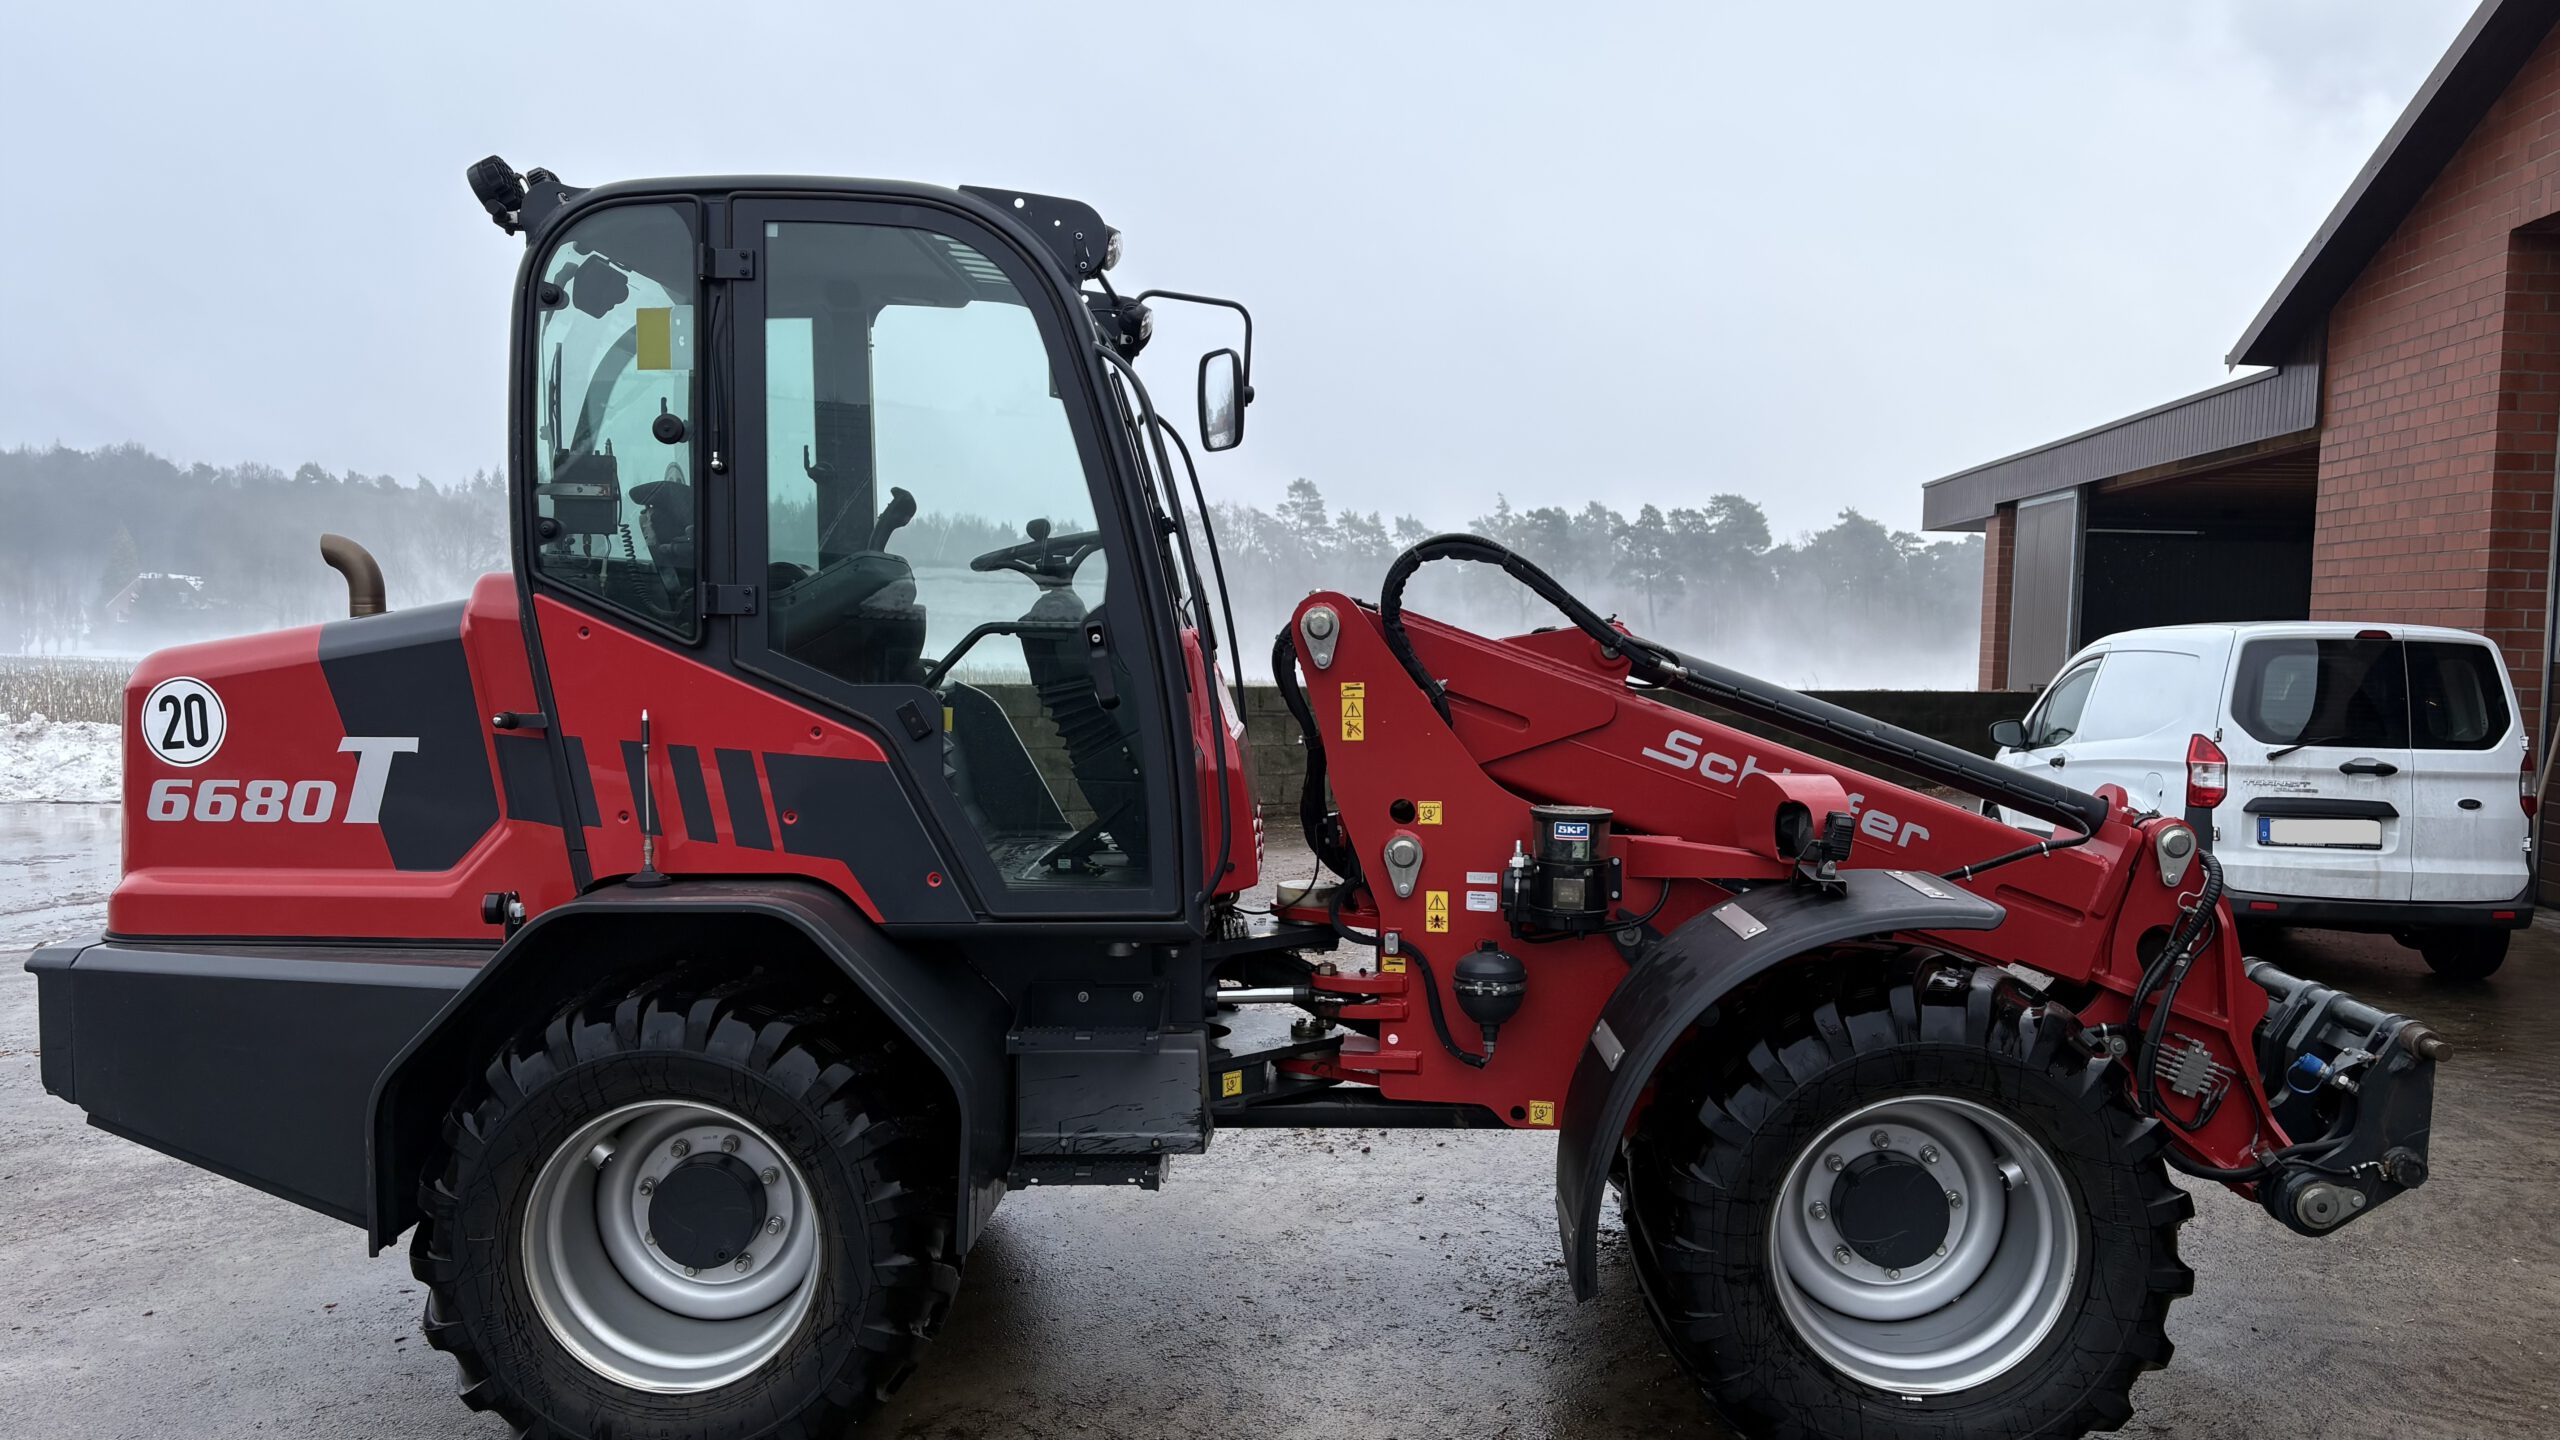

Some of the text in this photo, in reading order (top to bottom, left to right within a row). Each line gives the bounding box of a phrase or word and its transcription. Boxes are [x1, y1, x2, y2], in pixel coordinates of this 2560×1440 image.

[158, 692, 209, 750] 20
[1641, 729, 1930, 848] Schfer
[1558, 825, 1586, 834] SKF
